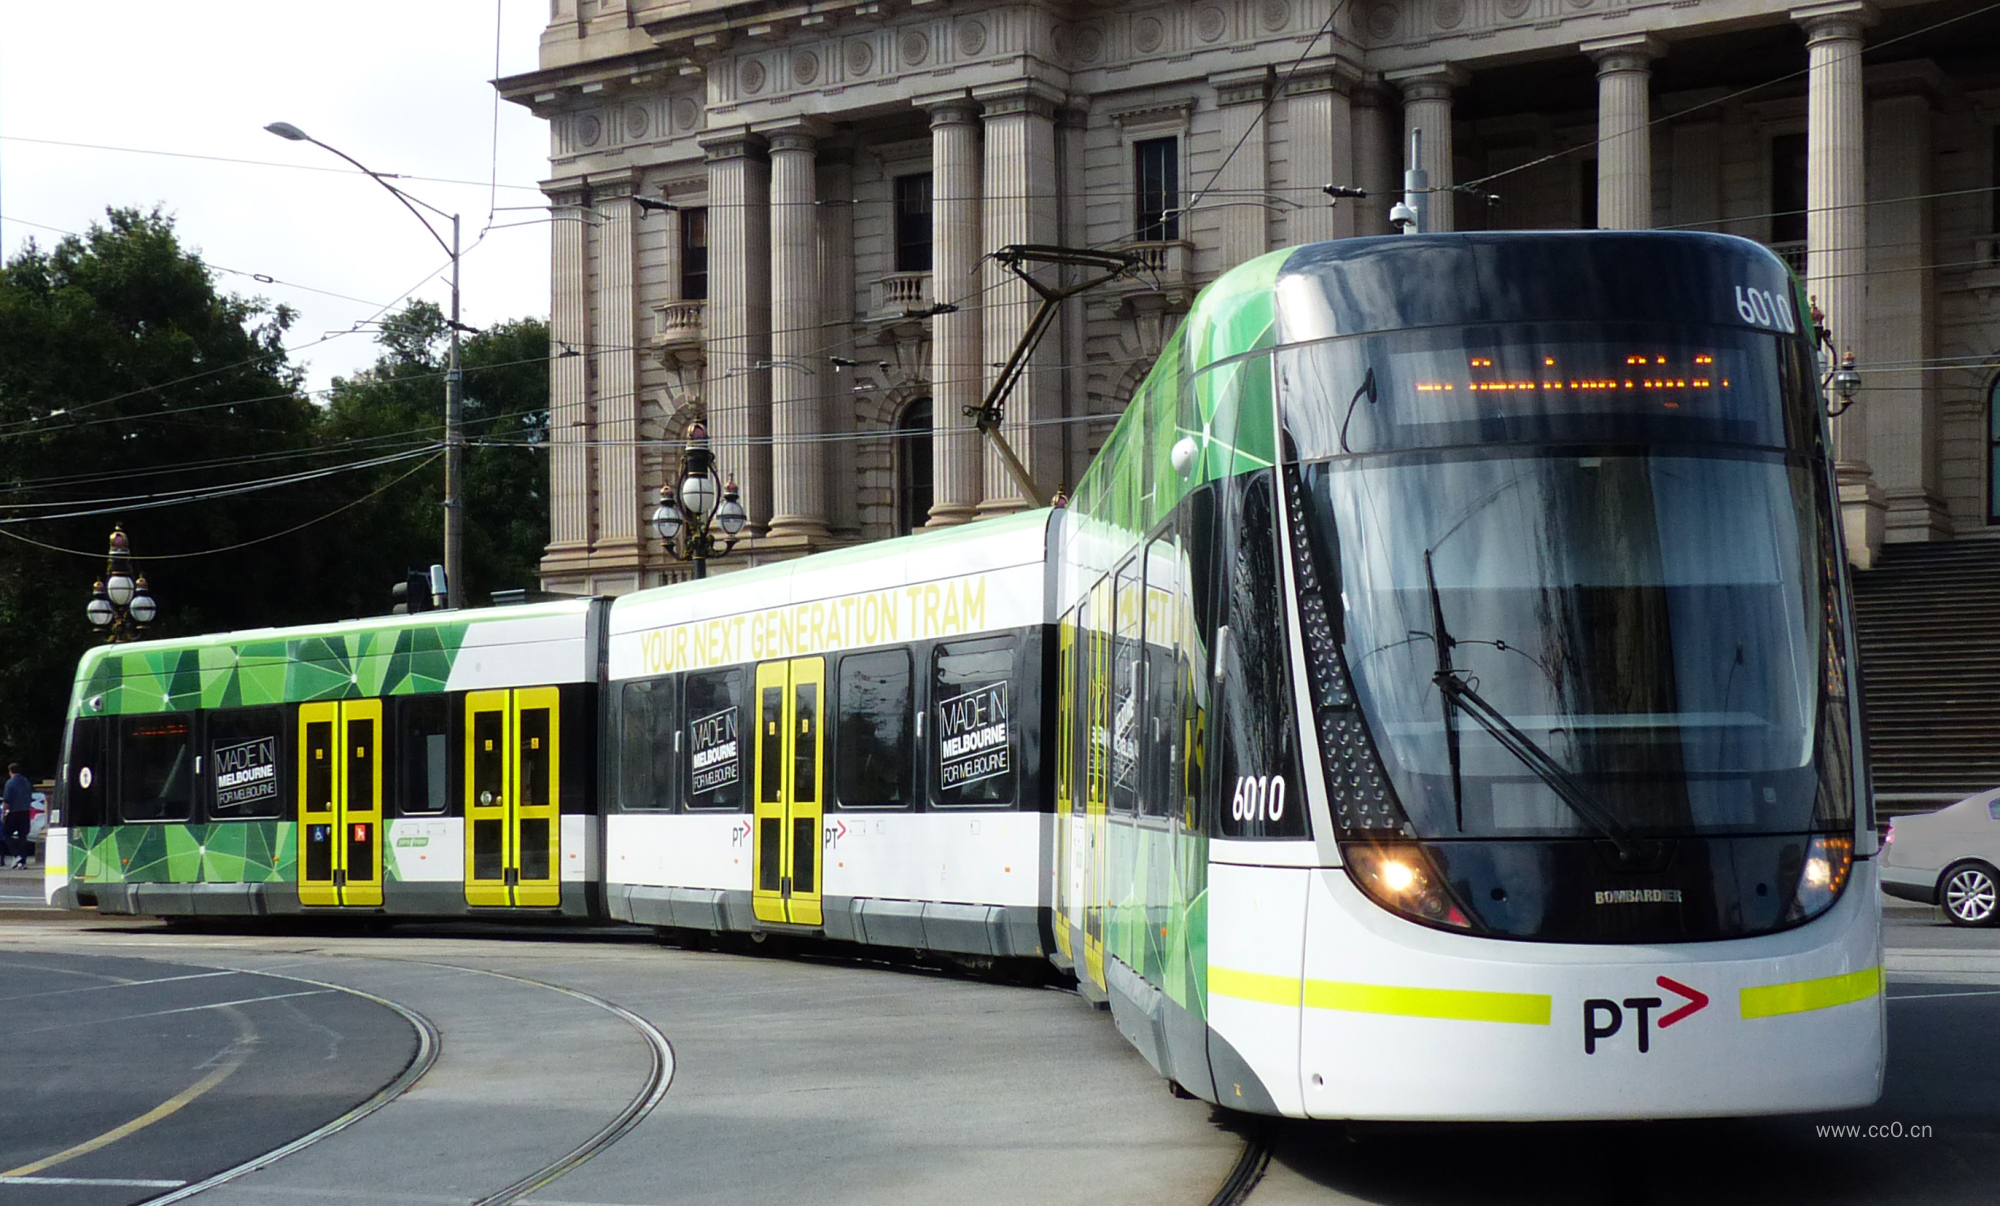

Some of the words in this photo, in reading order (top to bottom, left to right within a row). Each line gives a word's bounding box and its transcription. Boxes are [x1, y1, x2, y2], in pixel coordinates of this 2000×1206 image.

[1735, 285, 1796, 334] 6010
[640, 626, 688, 675] YOUR
[693, 615, 746, 668] NEXT
[751, 589, 898, 660] GENERATION
[906, 575, 986, 639] TRAM
[942, 693, 987, 738] MADE
[989, 687, 1006, 723] IN
[693, 715, 725, 752] MADE
[943, 723, 1006, 759] MELBOURNE
[217, 745, 257, 773] MADE
[693, 741, 737, 769] MELBOURNE
[944, 765, 959, 784] FOR
[960, 751, 1007, 778] MELBOURNE
[218, 764, 274, 788] MELBOURNE
[695, 774, 704, 789] FOR
[219, 791, 233, 804] FOR
[233, 782, 275, 801] MELBOURNE
[1232, 775, 1286, 821] 6010
[1595, 889, 1682, 904] BOMBARDIER
